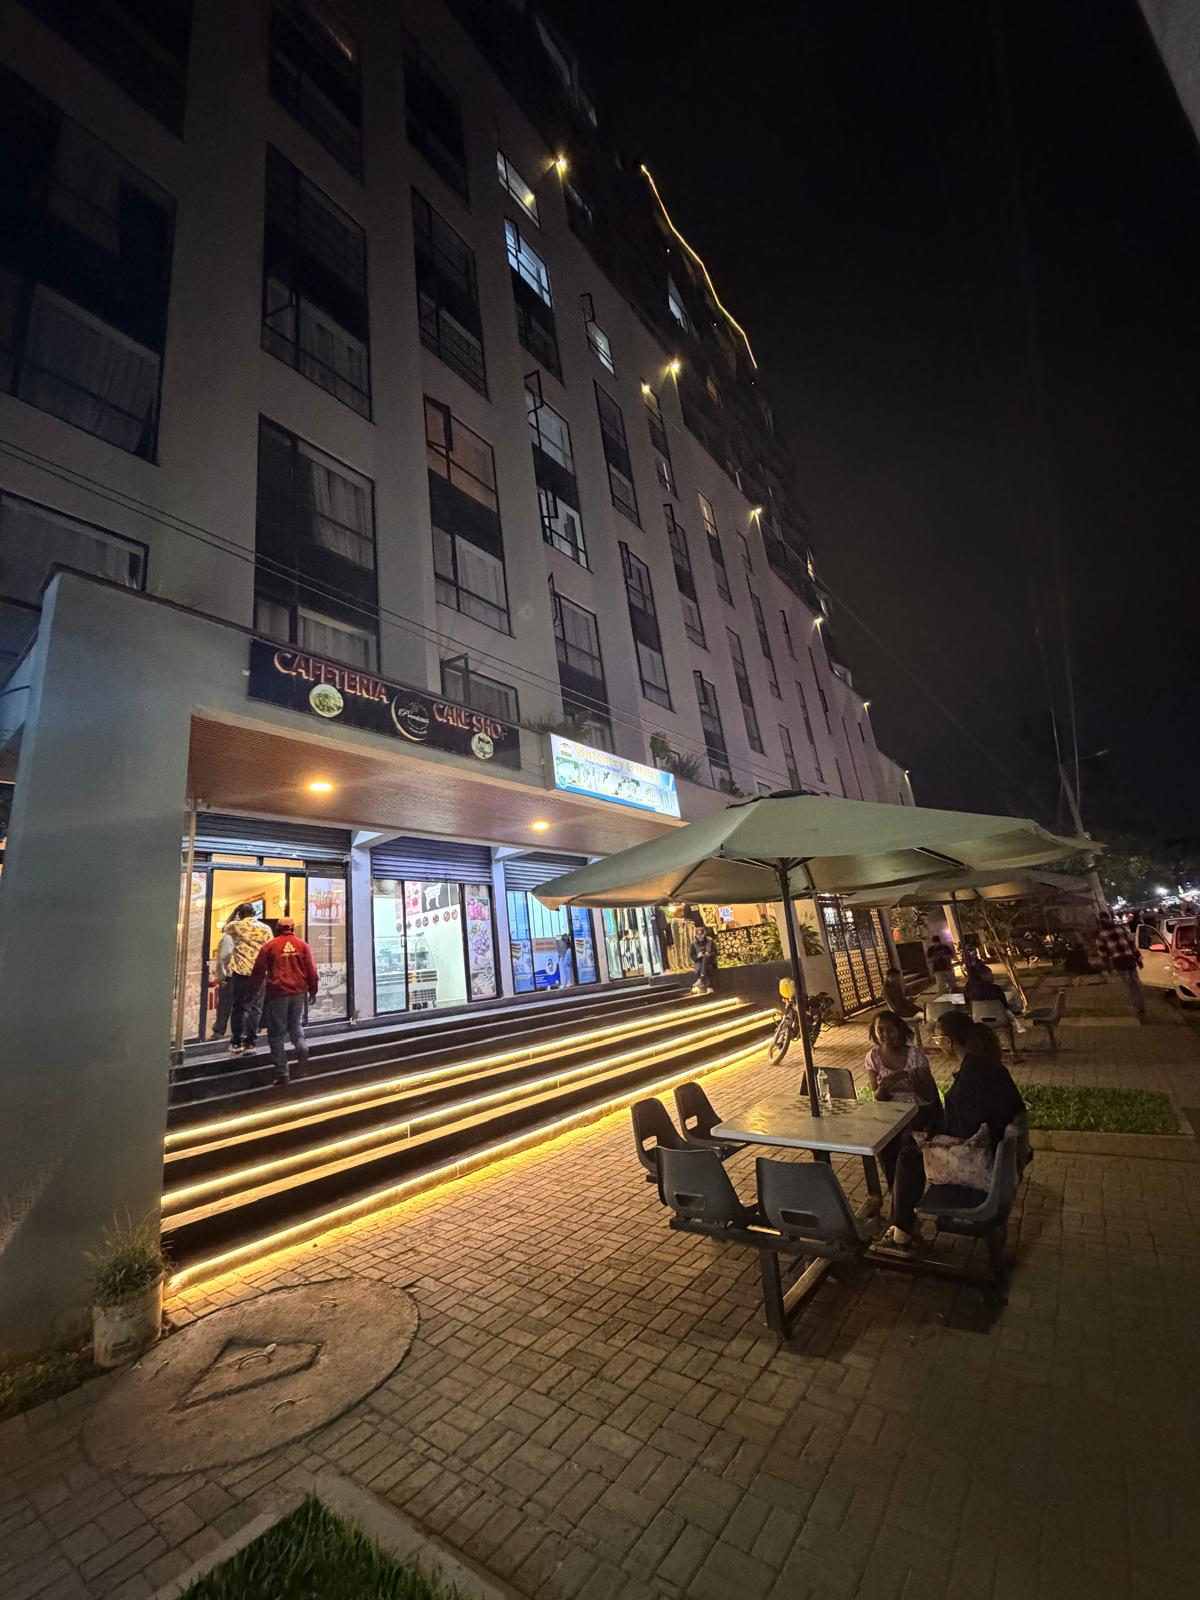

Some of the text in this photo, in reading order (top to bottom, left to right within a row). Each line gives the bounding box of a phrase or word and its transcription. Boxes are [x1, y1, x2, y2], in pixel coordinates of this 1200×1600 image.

[273, 649, 390, 705] CAFETERIA
[432, 702, 508, 741] CAKE SHOP
